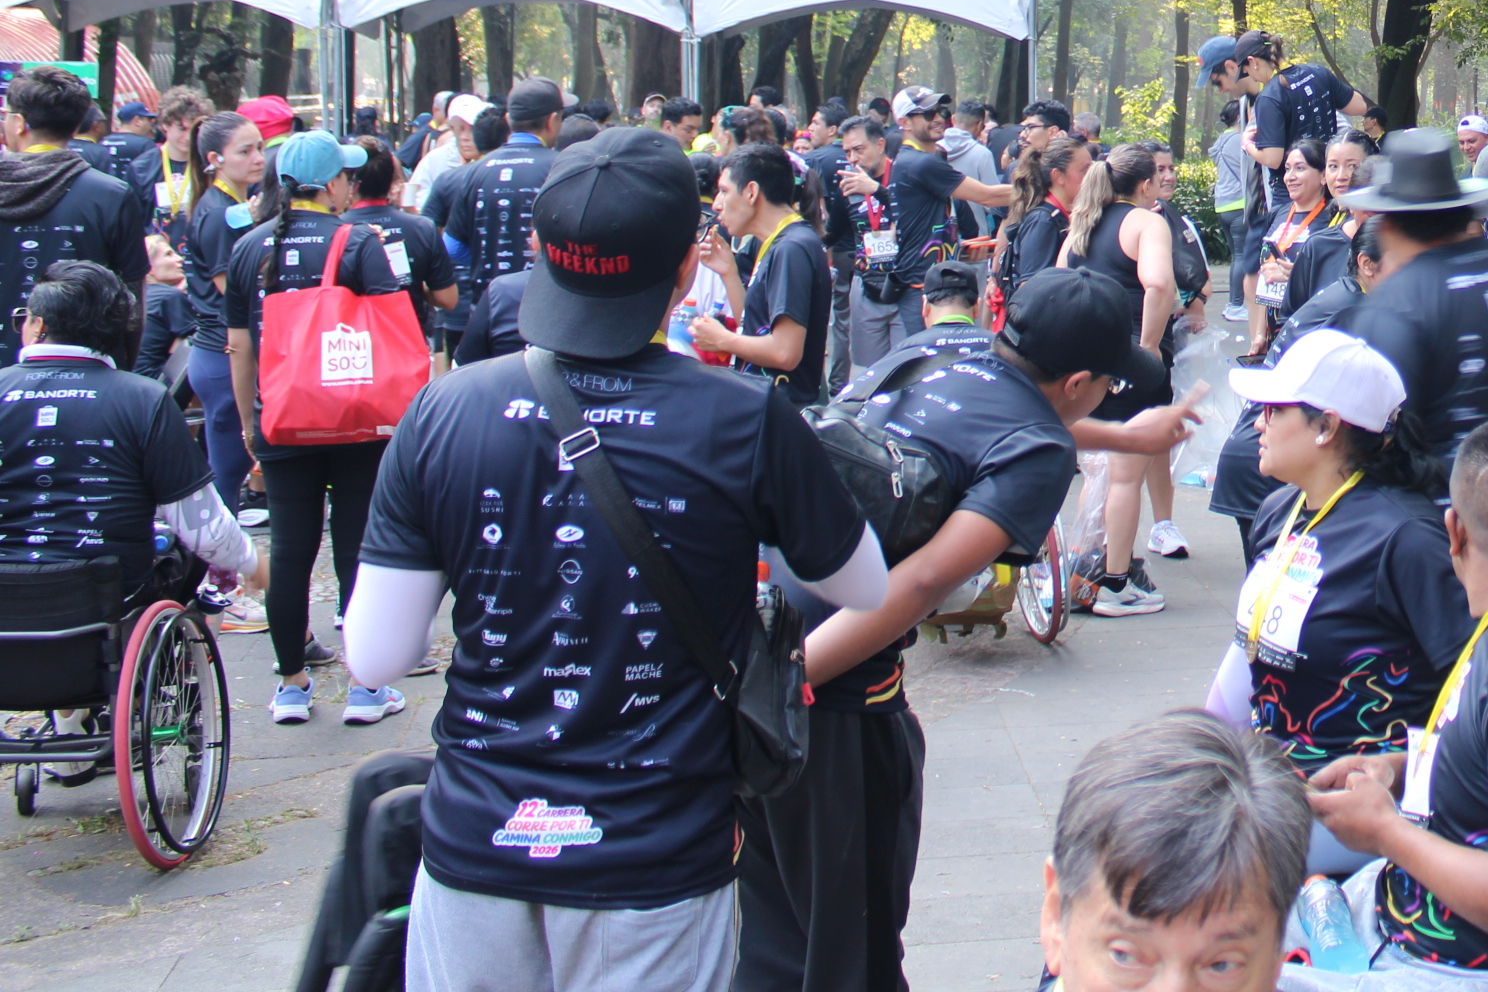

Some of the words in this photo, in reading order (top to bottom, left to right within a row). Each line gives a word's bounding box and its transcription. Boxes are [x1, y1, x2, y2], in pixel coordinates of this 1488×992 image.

[564, 239, 599, 256] THE
[545, 242, 631, 275] WEEKND
[327, 337, 367, 353] MINI
[947, 337, 990, 345] BANORTE
[24, 389, 98, 400] BANORTE
[537, 404, 657, 426] BORTE
[634, 694, 660, 707] MVS
[537, 808, 584, 818] CARRERA
[507, 820, 549, 832] CORRE
[550, 819, 575, 831] POR
[578, 818, 591, 829] TI
[494, 832, 541, 844] CAMINA
[543, 830, 601, 845] CONMIGO
[532, 845, 559, 855] 2026
